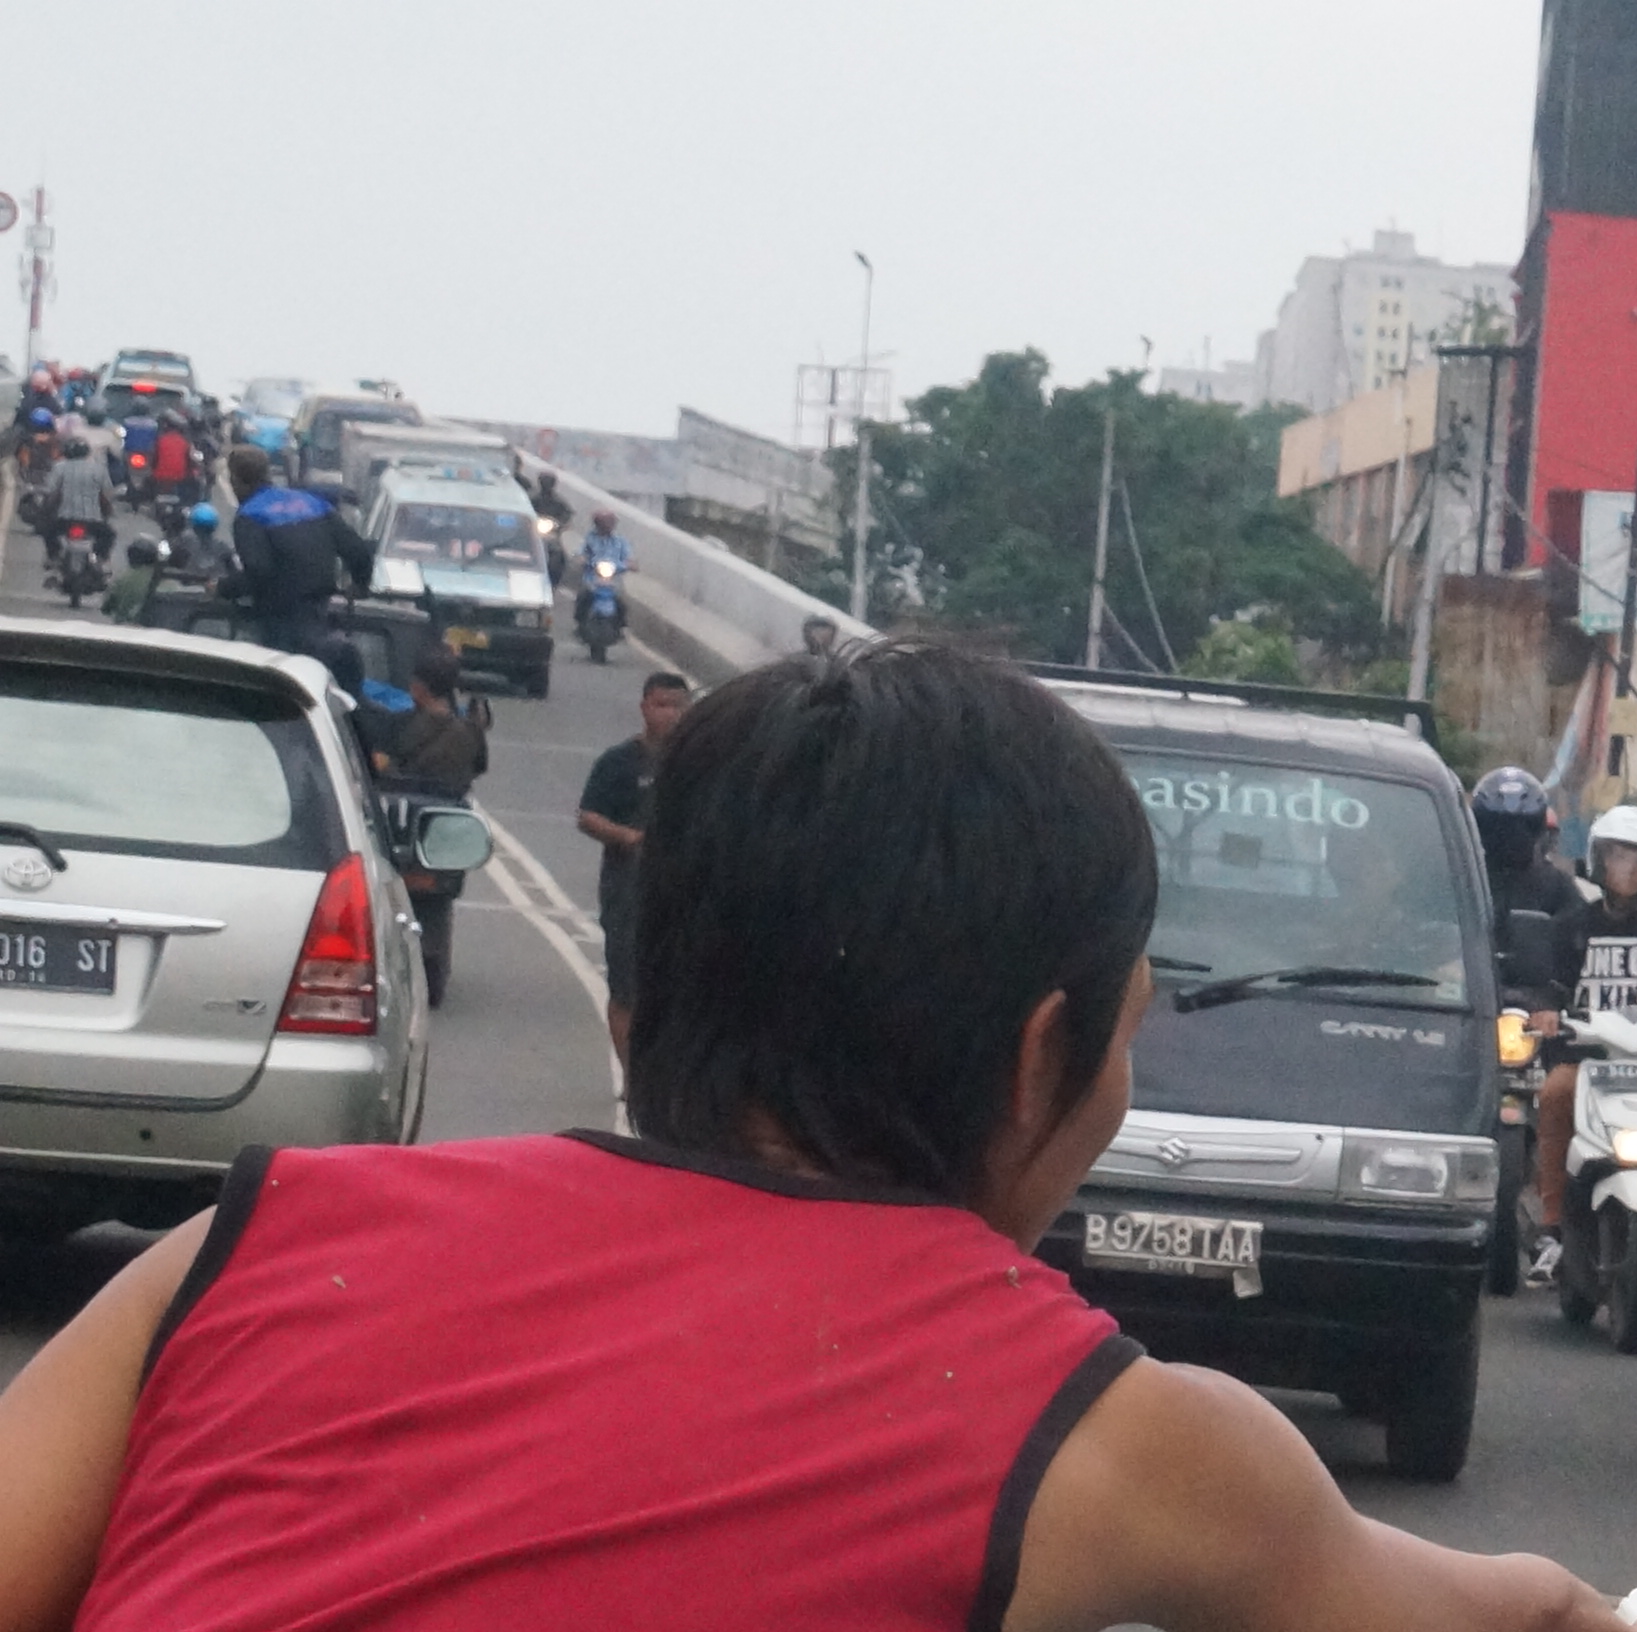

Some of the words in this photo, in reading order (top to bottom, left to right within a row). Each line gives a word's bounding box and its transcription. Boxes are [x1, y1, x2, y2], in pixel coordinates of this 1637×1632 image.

[1129, 770, 1370, 829] asindo
[77, 939, 112, 972] ST
[1085, 1214, 1107, 1249] B
